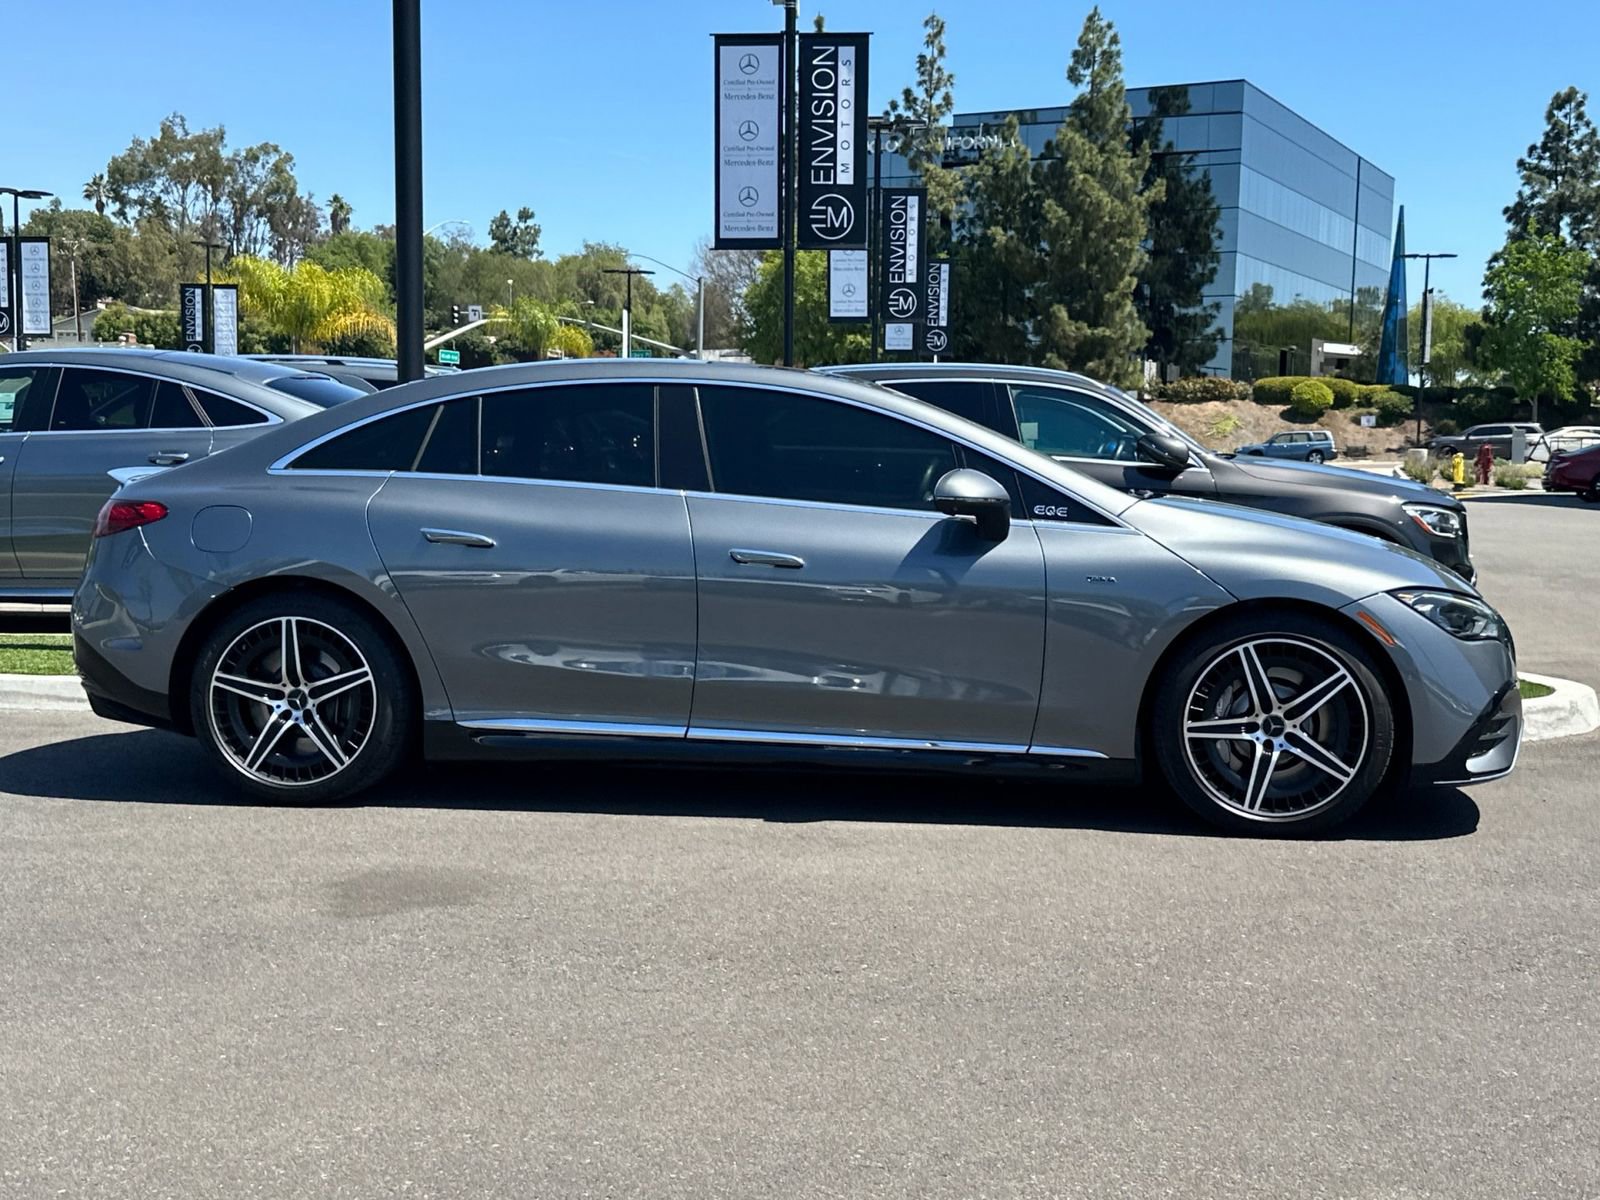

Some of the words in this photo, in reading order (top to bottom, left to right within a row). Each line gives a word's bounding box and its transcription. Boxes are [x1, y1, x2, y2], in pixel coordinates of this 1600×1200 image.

[811, 46, 835, 184] ENVISION
[841, 59, 852, 173] MOTORS
[889, 196, 906, 283] ENVISION
[908, 204, 916, 276] MOTORS
[185, 287, 195, 341] ENVISION
[927, 263, 940, 326] ENVISION
[1033, 505, 1068, 517] EQE
